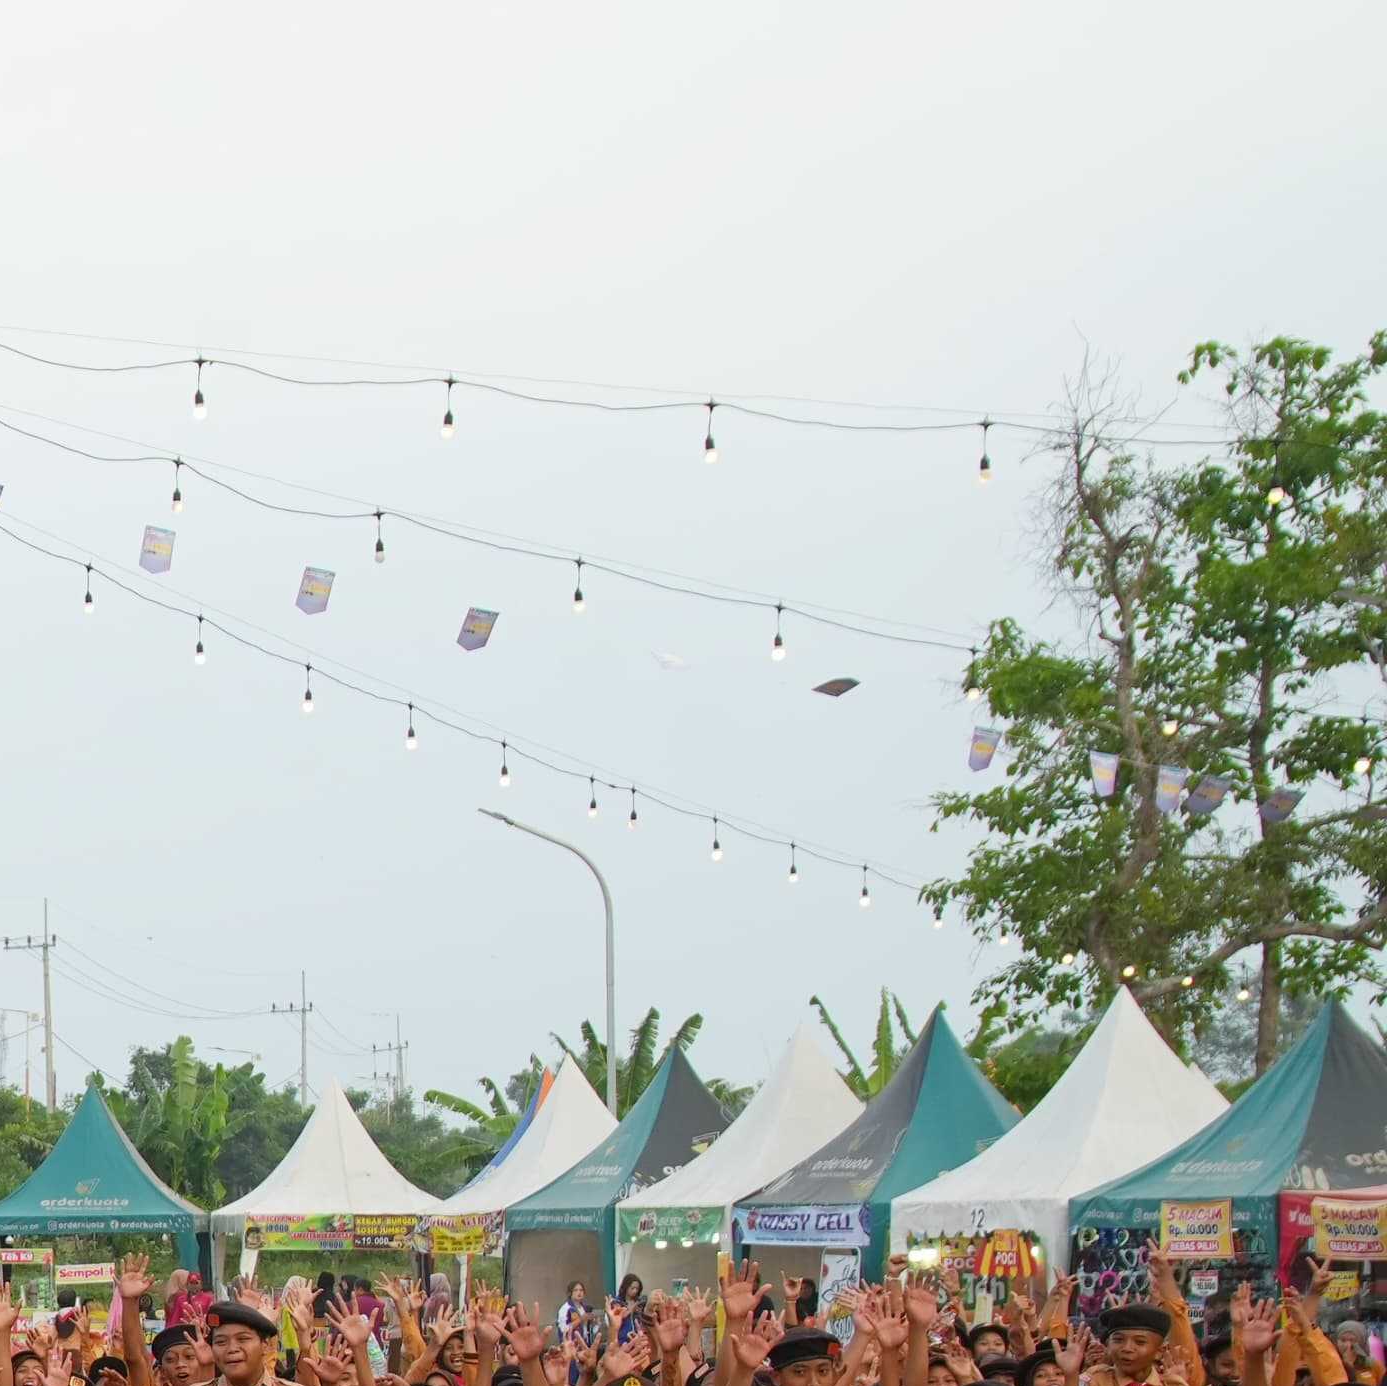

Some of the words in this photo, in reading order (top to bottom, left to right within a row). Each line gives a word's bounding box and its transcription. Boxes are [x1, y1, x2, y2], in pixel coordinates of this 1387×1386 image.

[40, 1197, 129, 1208] orderkuota
[970, 1208, 987, 1229] 12
[1168, 1207, 1176, 1221] 5
[1179, 1207, 1223, 1221] MACAM
[814, 1212, 854, 1231] CELL
[1186, 1223, 1219, 1235] 10.000
[1346, 1224, 1379, 1236] 10.000
[995, 1251, 1017, 1265] POCI
[58, 1268, 104, 1279] Sempol
